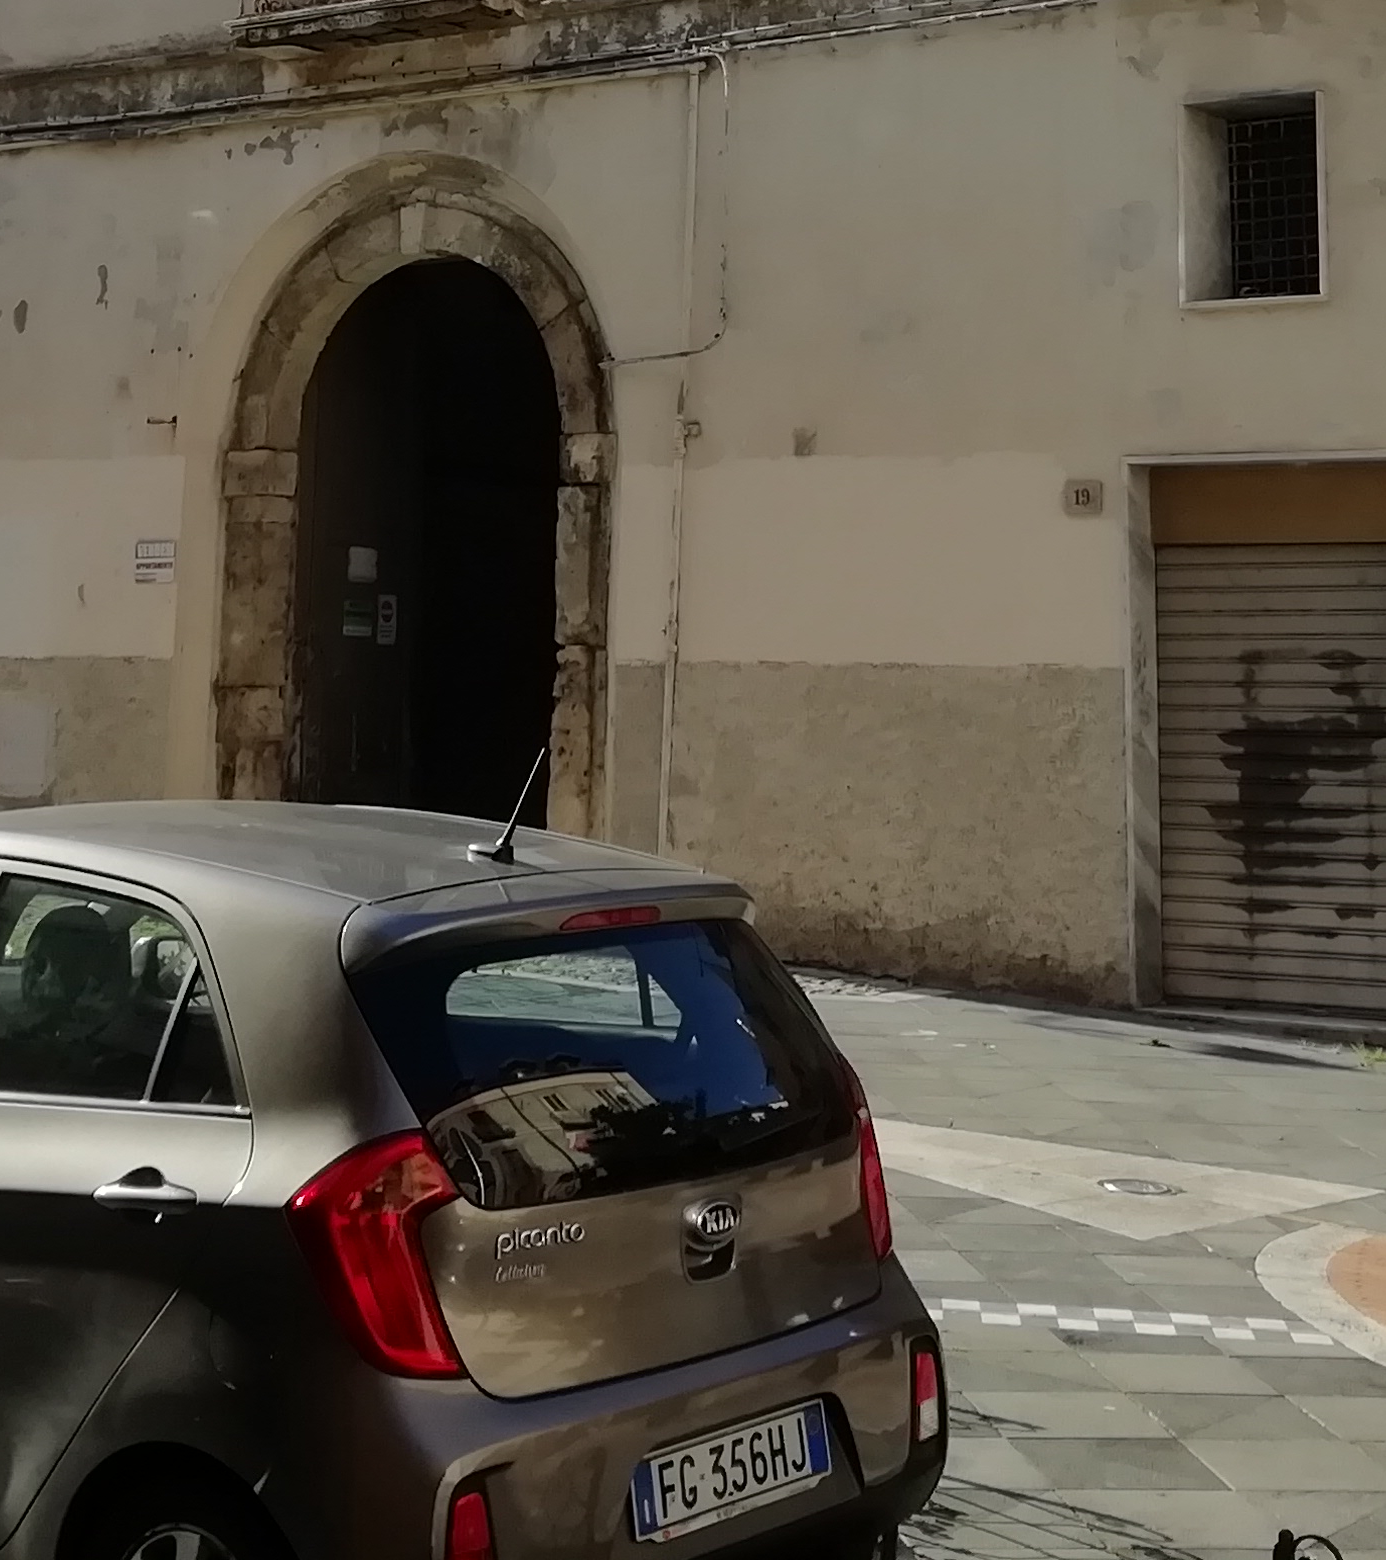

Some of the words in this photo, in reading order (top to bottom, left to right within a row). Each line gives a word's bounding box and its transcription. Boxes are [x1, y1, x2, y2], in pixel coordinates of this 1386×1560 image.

[1073, 487, 1091, 507] 19
[704, 1207, 735, 1234] KIA
[494, 1221, 586, 1260] picanto
[657, 1454, 698, 1519] FG
[708, 1417, 807, 1500] 356HJ
